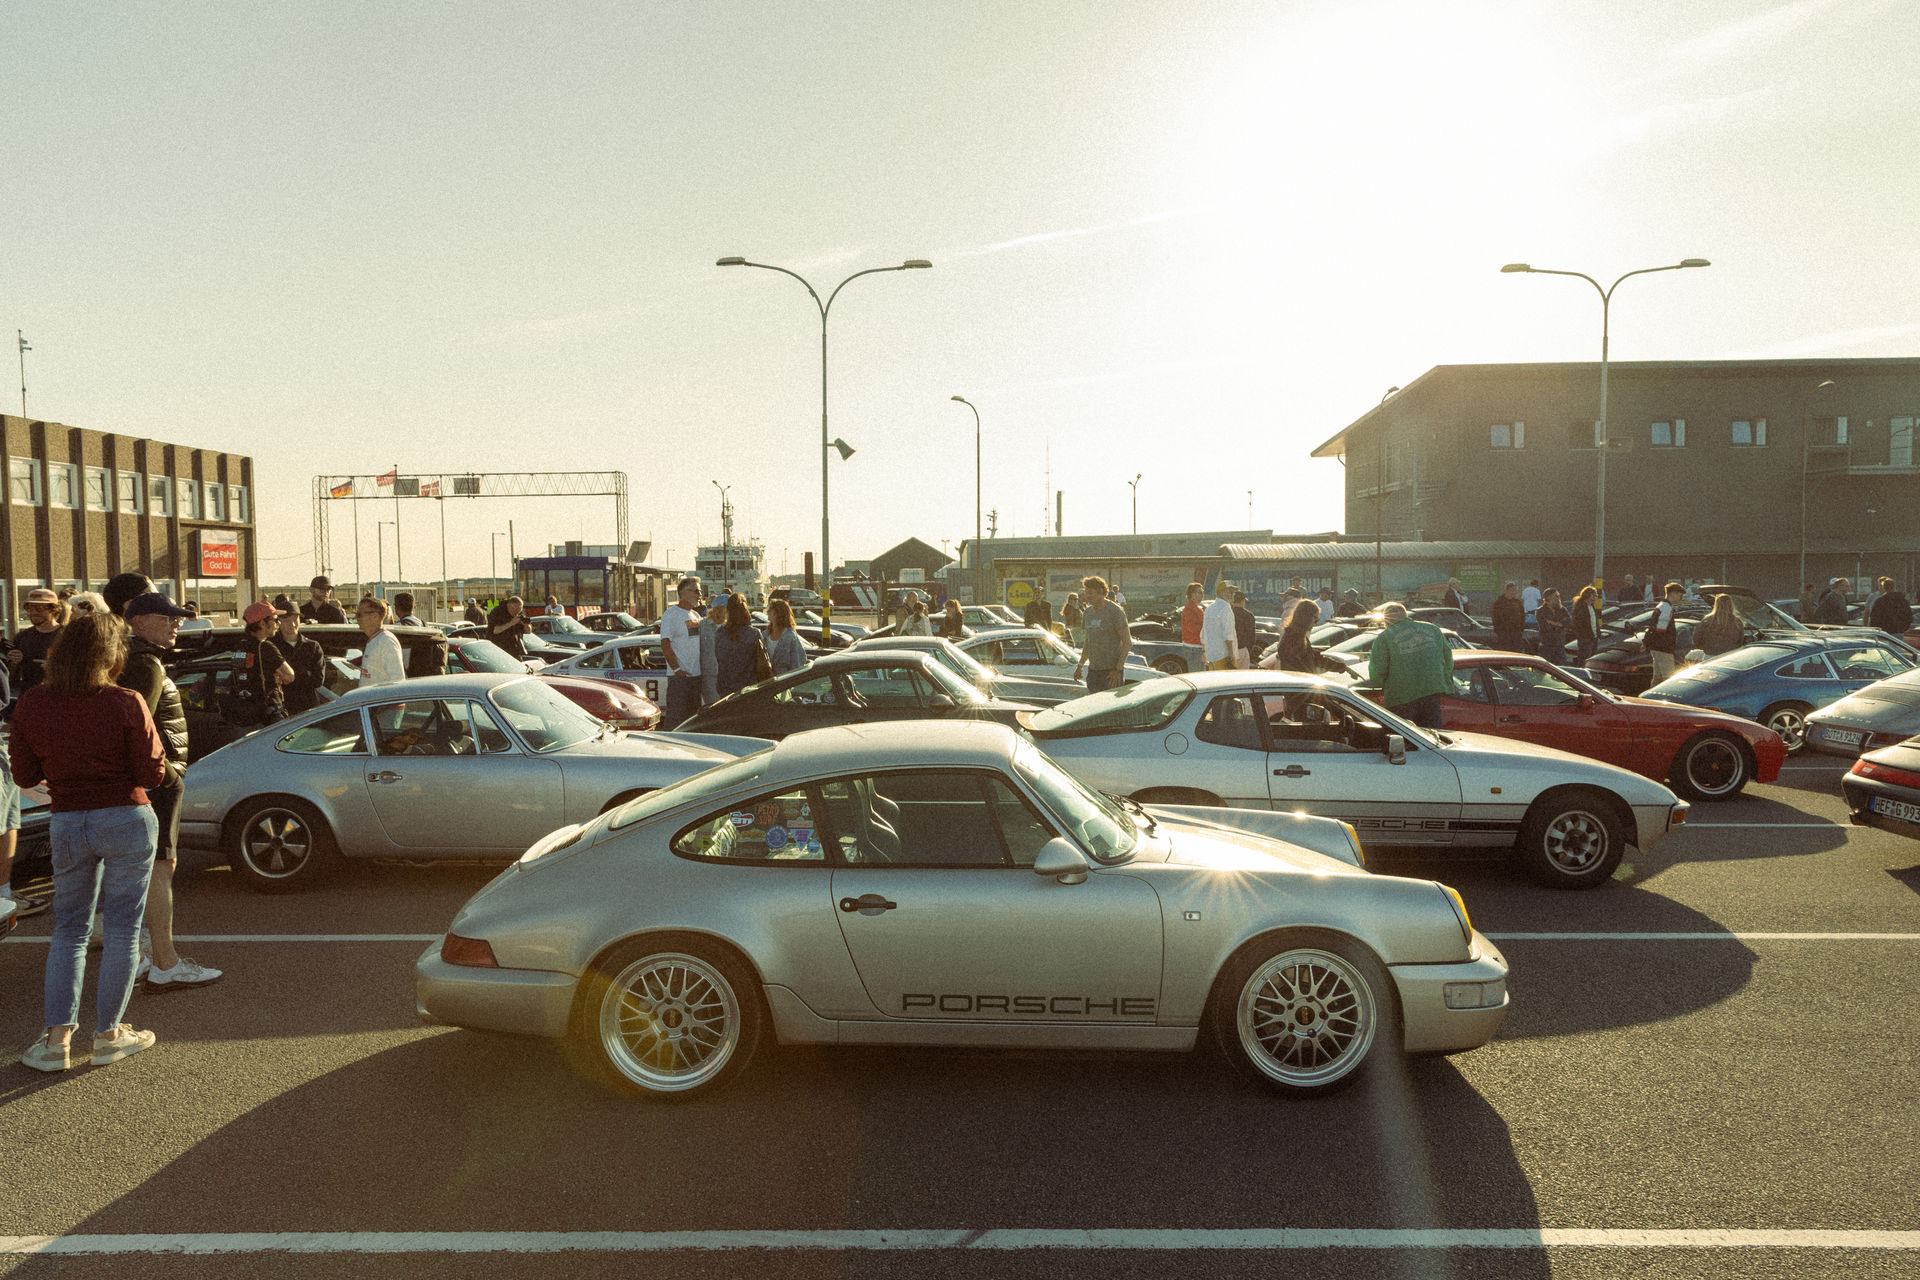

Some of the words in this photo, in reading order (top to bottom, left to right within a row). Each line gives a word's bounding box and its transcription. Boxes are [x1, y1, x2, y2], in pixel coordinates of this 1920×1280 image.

[204, 550, 219, 558] Gute
[220, 550, 235, 558] Fahrt
[210, 561, 222, 569] God
[1265, 578, 1331, 594] AQURIUM
[646, 680, 658, 701] 8
[1875, 796, 1890, 814] HEF
[1895, 801, 1901, 816] G
[1904, 802, 1920, 821] 993
[1341, 818, 1445, 830] RSCHE
[902, 993, 1155, 1015] PORSCHE
